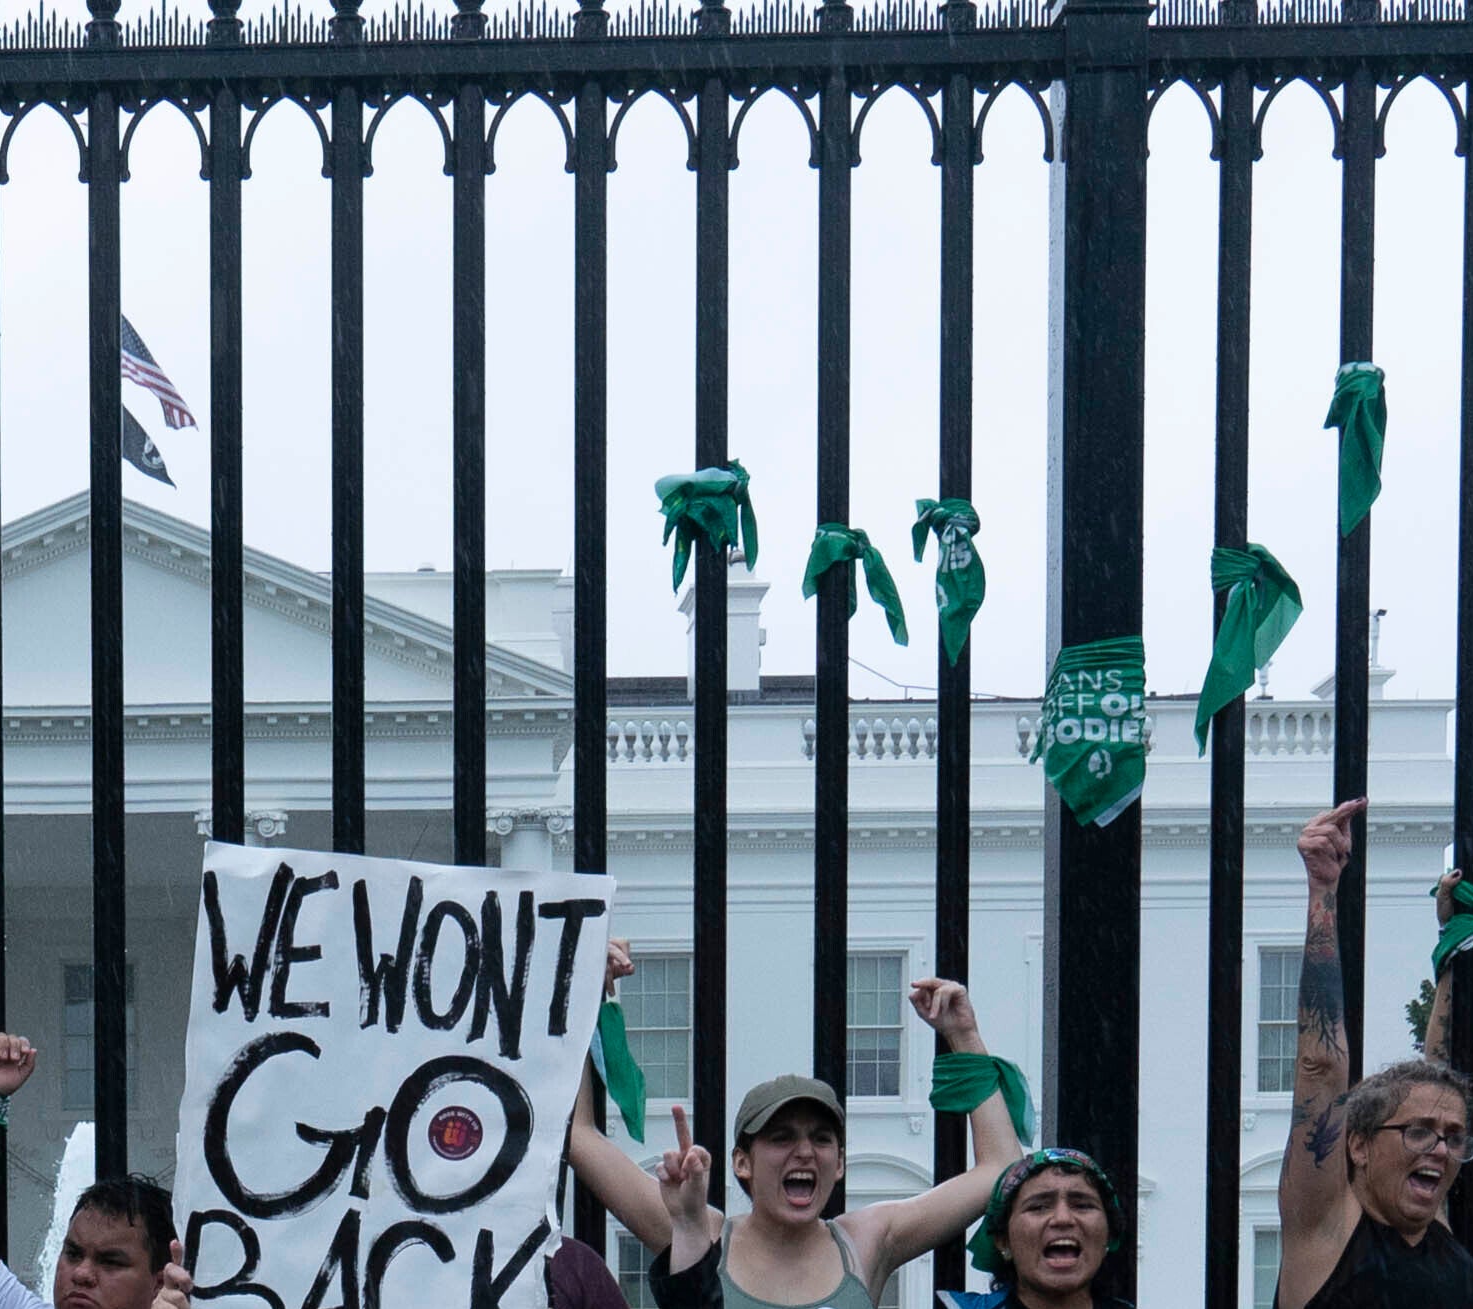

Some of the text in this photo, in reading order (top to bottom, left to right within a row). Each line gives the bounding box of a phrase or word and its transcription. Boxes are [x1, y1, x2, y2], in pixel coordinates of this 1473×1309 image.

[1048, 718, 1142, 745] ODIE
[1054, 669, 1122, 692] ANS
[203, 862, 606, 1060] WE WONT
[204, 1031, 534, 1220] GO
